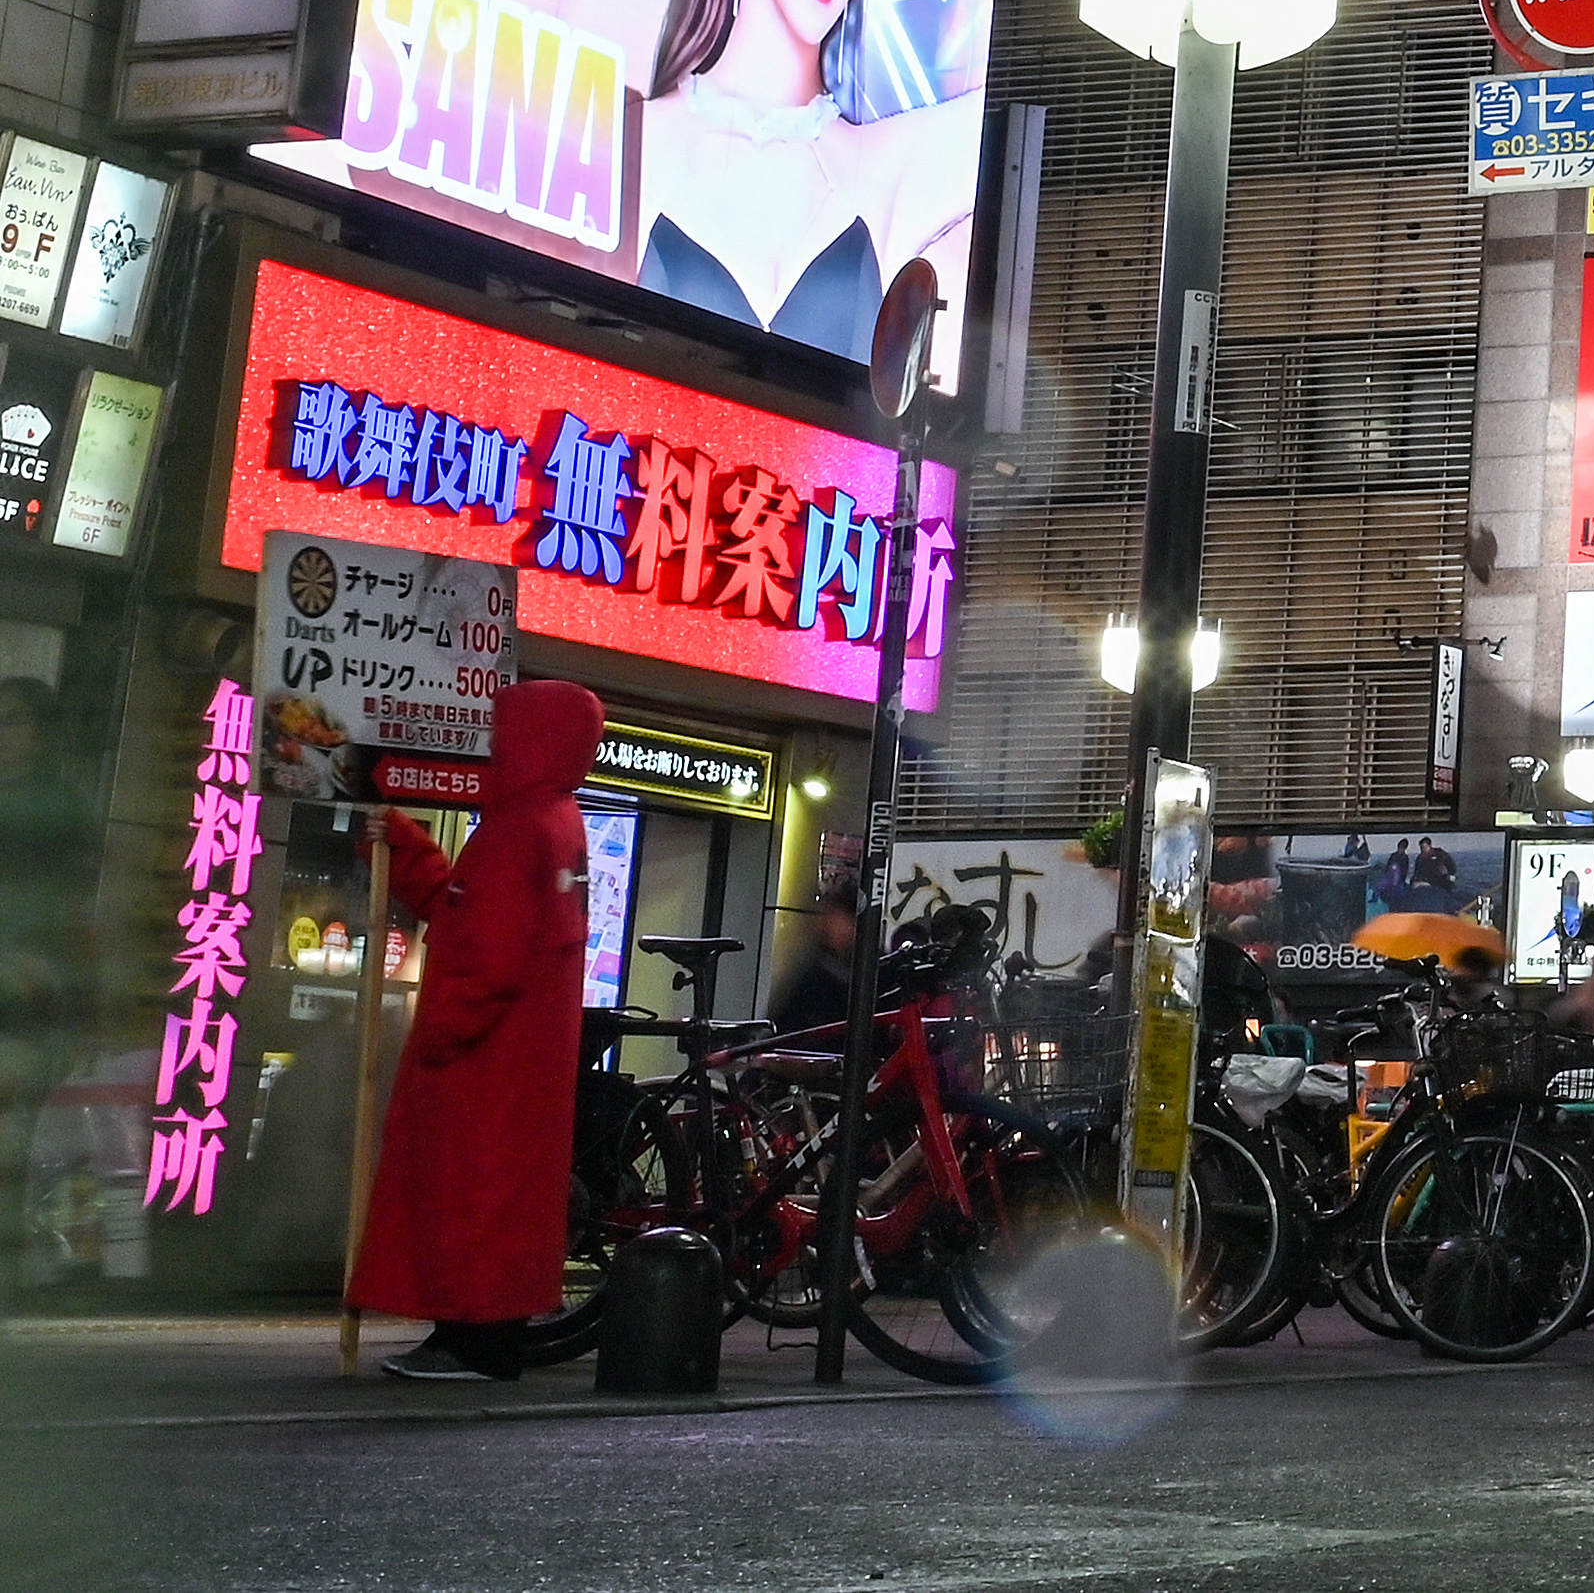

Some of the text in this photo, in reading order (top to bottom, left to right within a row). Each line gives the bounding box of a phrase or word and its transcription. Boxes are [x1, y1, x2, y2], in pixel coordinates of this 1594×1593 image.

[91, 393, 154, 422] リラクゼーション
[81, 526, 102, 545] 6F
[291, 380, 956, 660] 歌舞伎町 無料案内所
[344, 565, 414, 600] チャージ
[285, 615, 336, 644] Darts
[343, 608, 453, 649] オールゲーム
[282, 645, 335, 694] UP
[341, 656, 416, 692] ドリンク
[385, 765, 481, 795] お店はこちら
[1529, 851, 1566, 880] 9F
[143, 677, 262, 1217] 無料案内所
